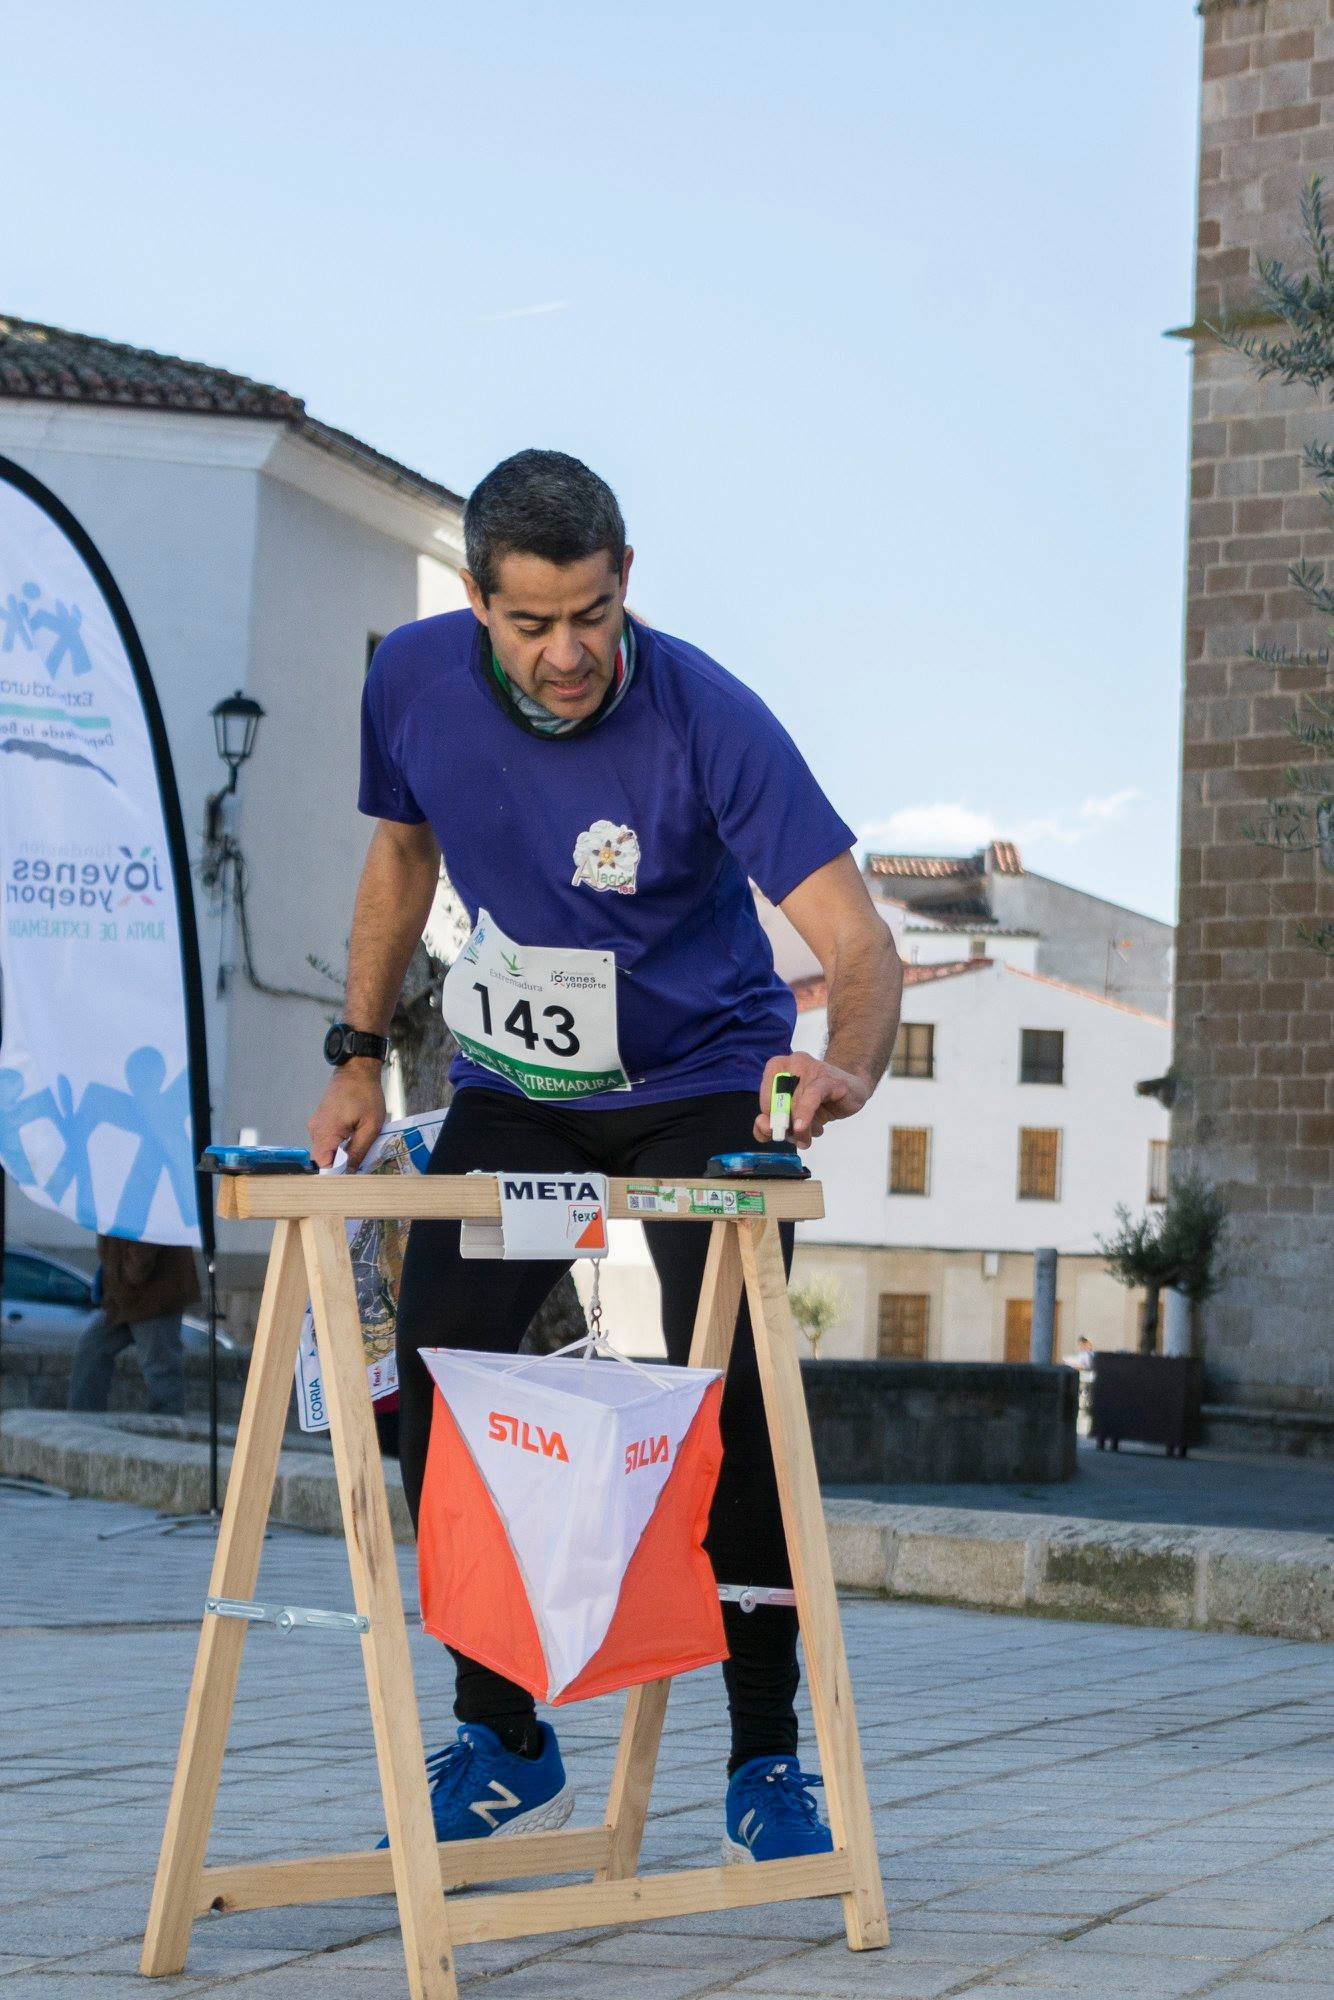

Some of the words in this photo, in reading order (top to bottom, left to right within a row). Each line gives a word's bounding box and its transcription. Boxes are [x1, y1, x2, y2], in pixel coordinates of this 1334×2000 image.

[489, 968, 544, 992] Extremadura
[472, 982, 580, 1057] 143
[516, 1069, 618, 1091] EXTREMADURA
[504, 1181, 599, 1200] META
[309, 1378, 323, 1421] CORIA
[488, 1411, 570, 1463] SILVA
[625, 1435, 669, 1475] SILVA
